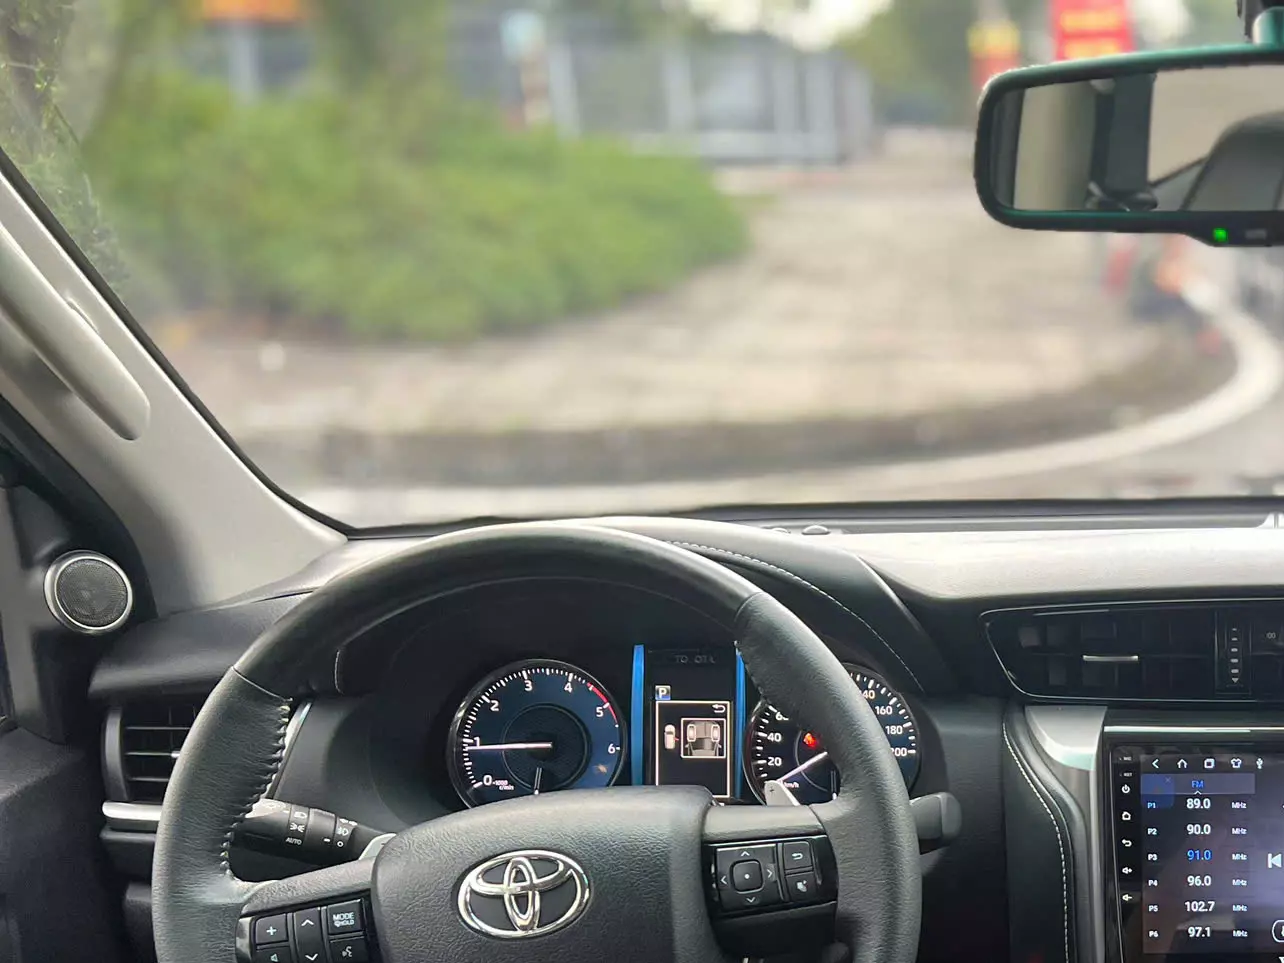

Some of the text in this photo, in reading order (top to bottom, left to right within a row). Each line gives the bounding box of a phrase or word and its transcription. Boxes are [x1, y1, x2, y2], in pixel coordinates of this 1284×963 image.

[524, 680, 532, 692] 3
[564, 682, 572, 693] 4
[859, 690, 876, 700] 40
[490, 701, 499, 712] 2
[596, 706, 604, 717] 5
[875, 706, 893, 715] 160
[885, 725, 903, 734] 180
[767, 733, 782, 742] 40
[608, 744, 616, 754] 6
[768, 757, 782, 766] 20
[483, 774, 492, 786] 0
[1186, 798, 1212, 809] 89.0
[1186, 824, 1212, 834] 90.0
[1187, 850, 1212, 860] 91.0
[1187, 876, 1212, 886] 96.0
[1184, 901, 1216, 912] 102.7
[332, 912, 354, 921] MODE
[1188, 926, 1211, 938] 97.1
